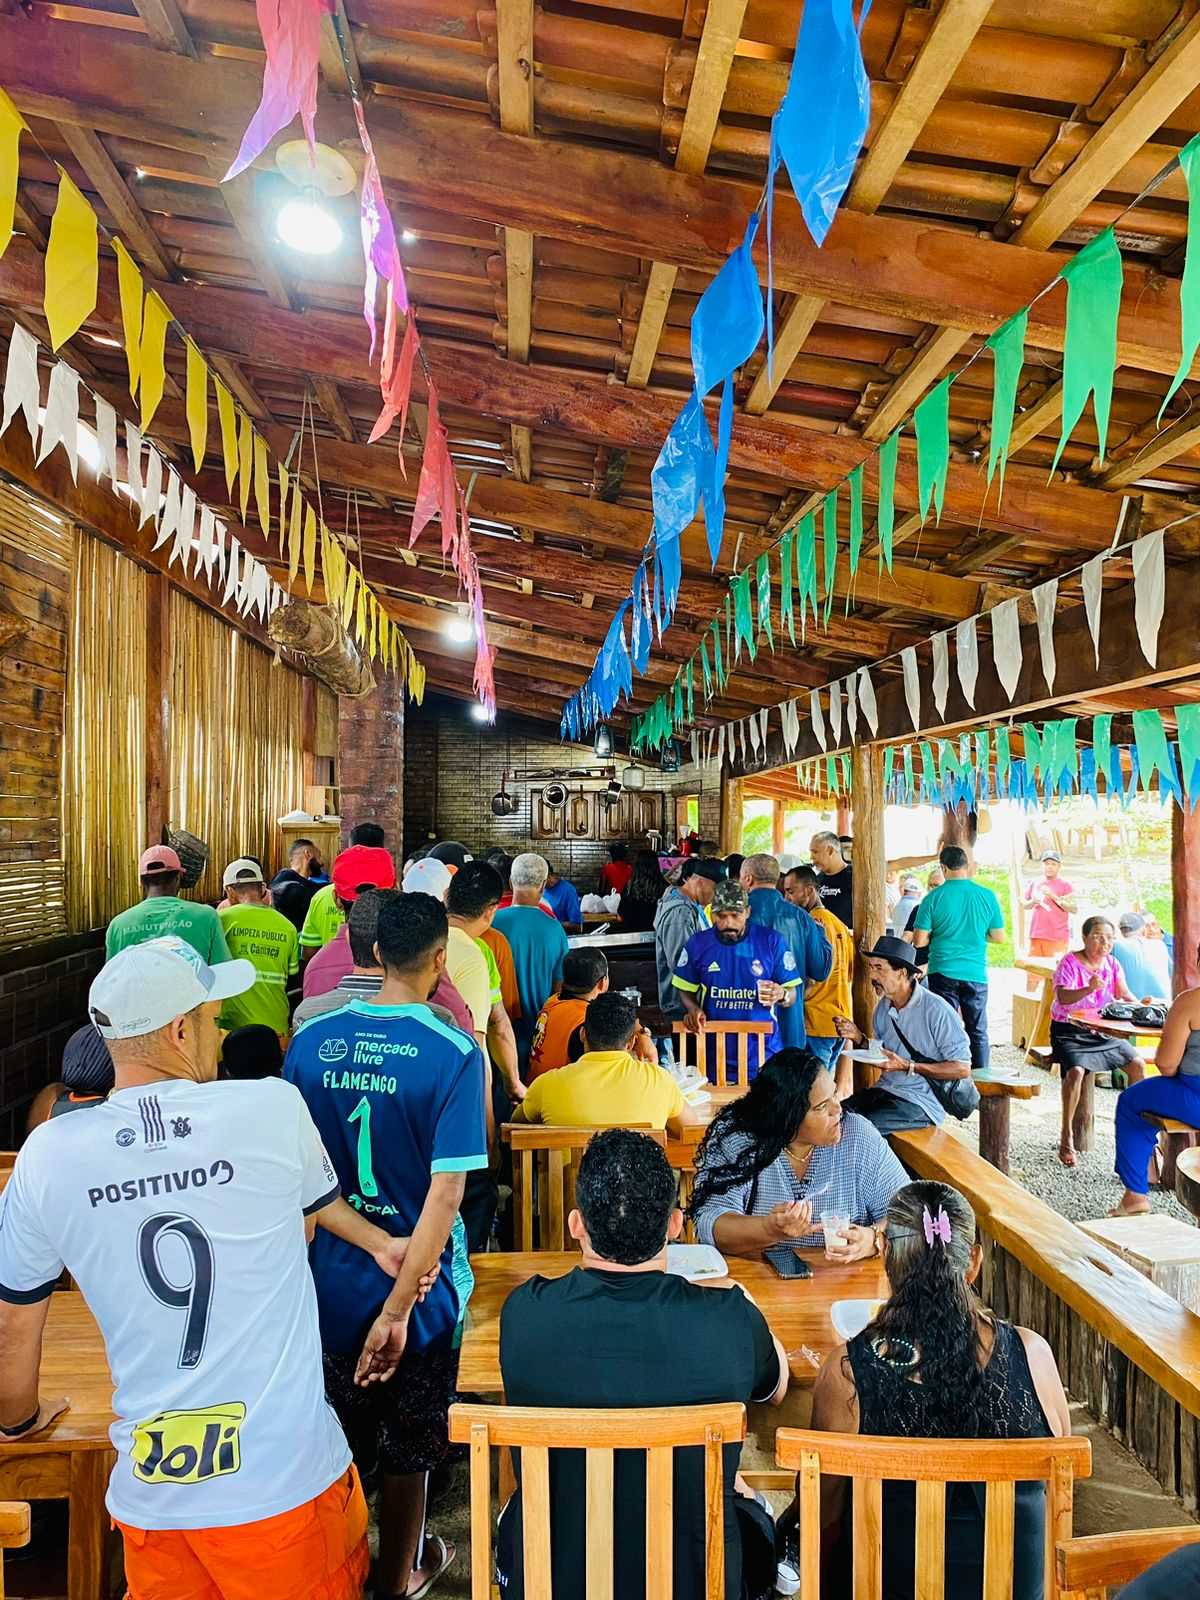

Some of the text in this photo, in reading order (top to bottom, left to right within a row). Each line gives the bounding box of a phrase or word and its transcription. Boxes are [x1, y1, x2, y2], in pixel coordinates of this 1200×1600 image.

[232, 928, 260, 938] LIMPEZA
[715, 1000, 754, 1010] FLY BETTER
[353, 1050, 384, 1065] livre
[355, 1040, 418, 1057] mercado
[322, 1070, 397, 1095] FLAMENGO
[347, 1095, 378, 1196] 1
[88, 1168, 208, 1208] POSITIVO
[136, 1211, 215, 1369] 9
[138, 1423, 236, 1478] Joli
